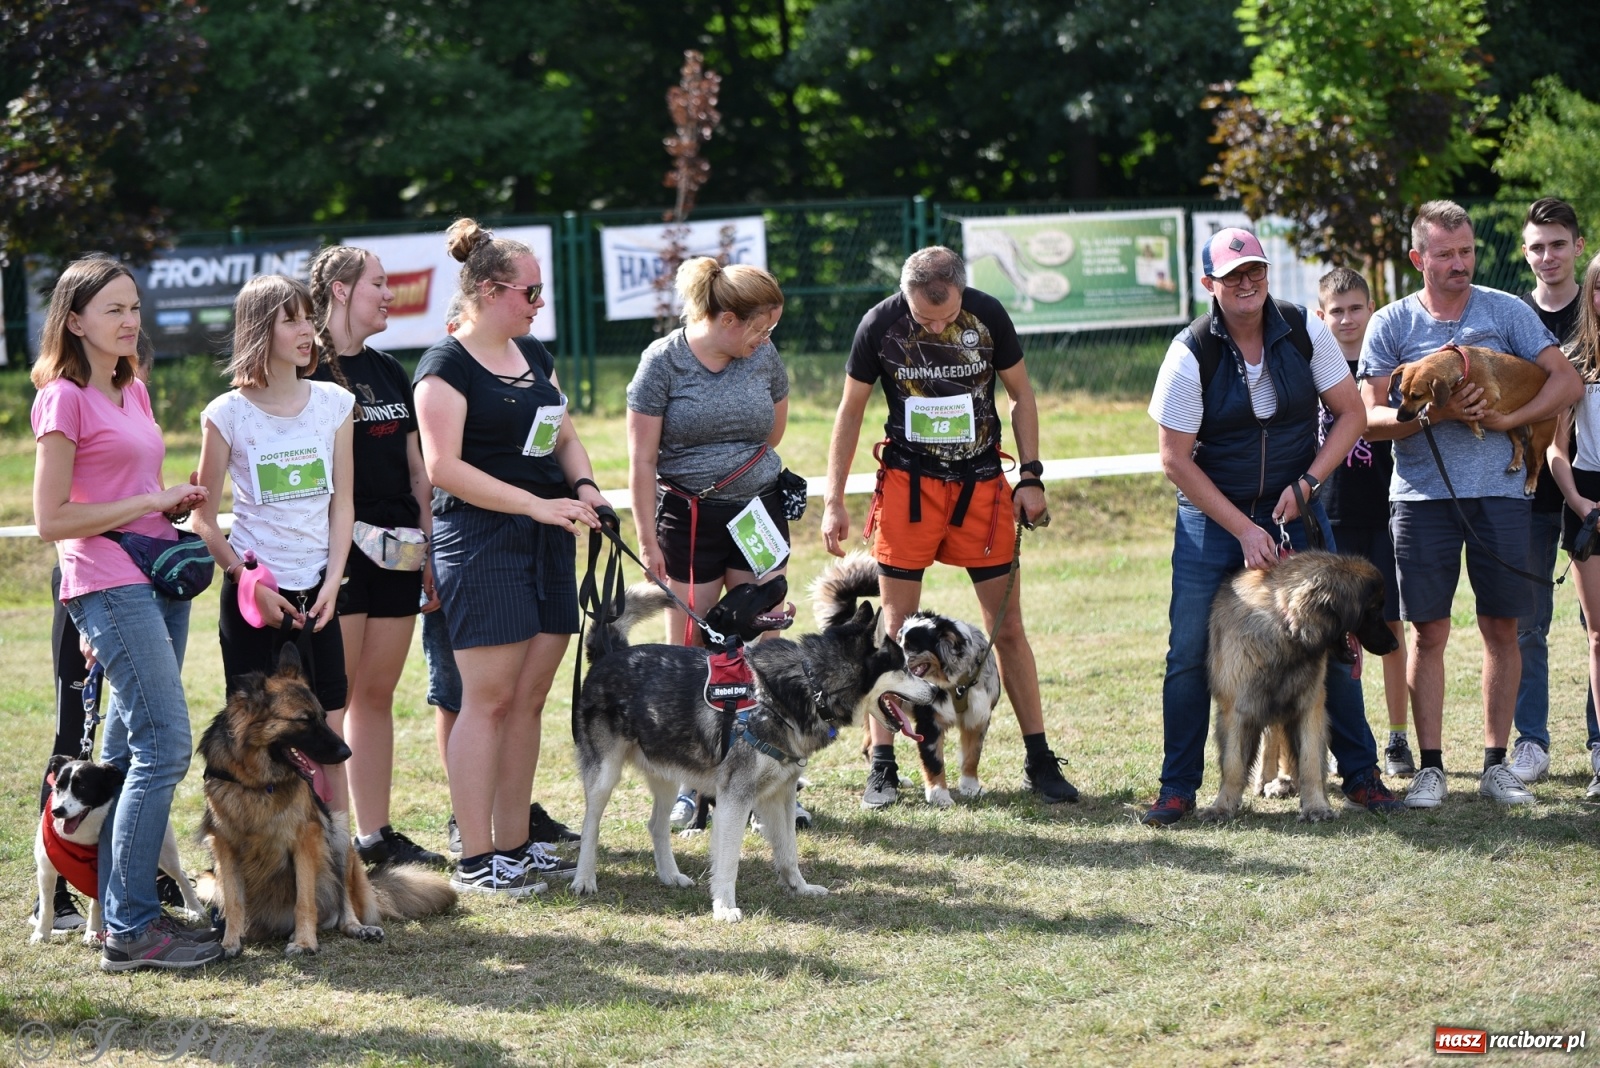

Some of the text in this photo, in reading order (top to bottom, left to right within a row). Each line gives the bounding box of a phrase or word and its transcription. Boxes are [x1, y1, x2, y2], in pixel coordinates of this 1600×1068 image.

[148, 251, 311, 289] FRONTLINE
[898, 361, 987, 379] RUNMAGEDDON
[914, 403, 966, 411] DOGTREKKING
[932, 420, 951, 434] 18
[260, 447, 317, 461] DOGTREKKING
[289, 470, 302, 486] 6
[753, 509, 782, 553] DOGTREKKING
[745, 534, 764, 556] 32
[714, 686, 747, 696] Rebel Dog
